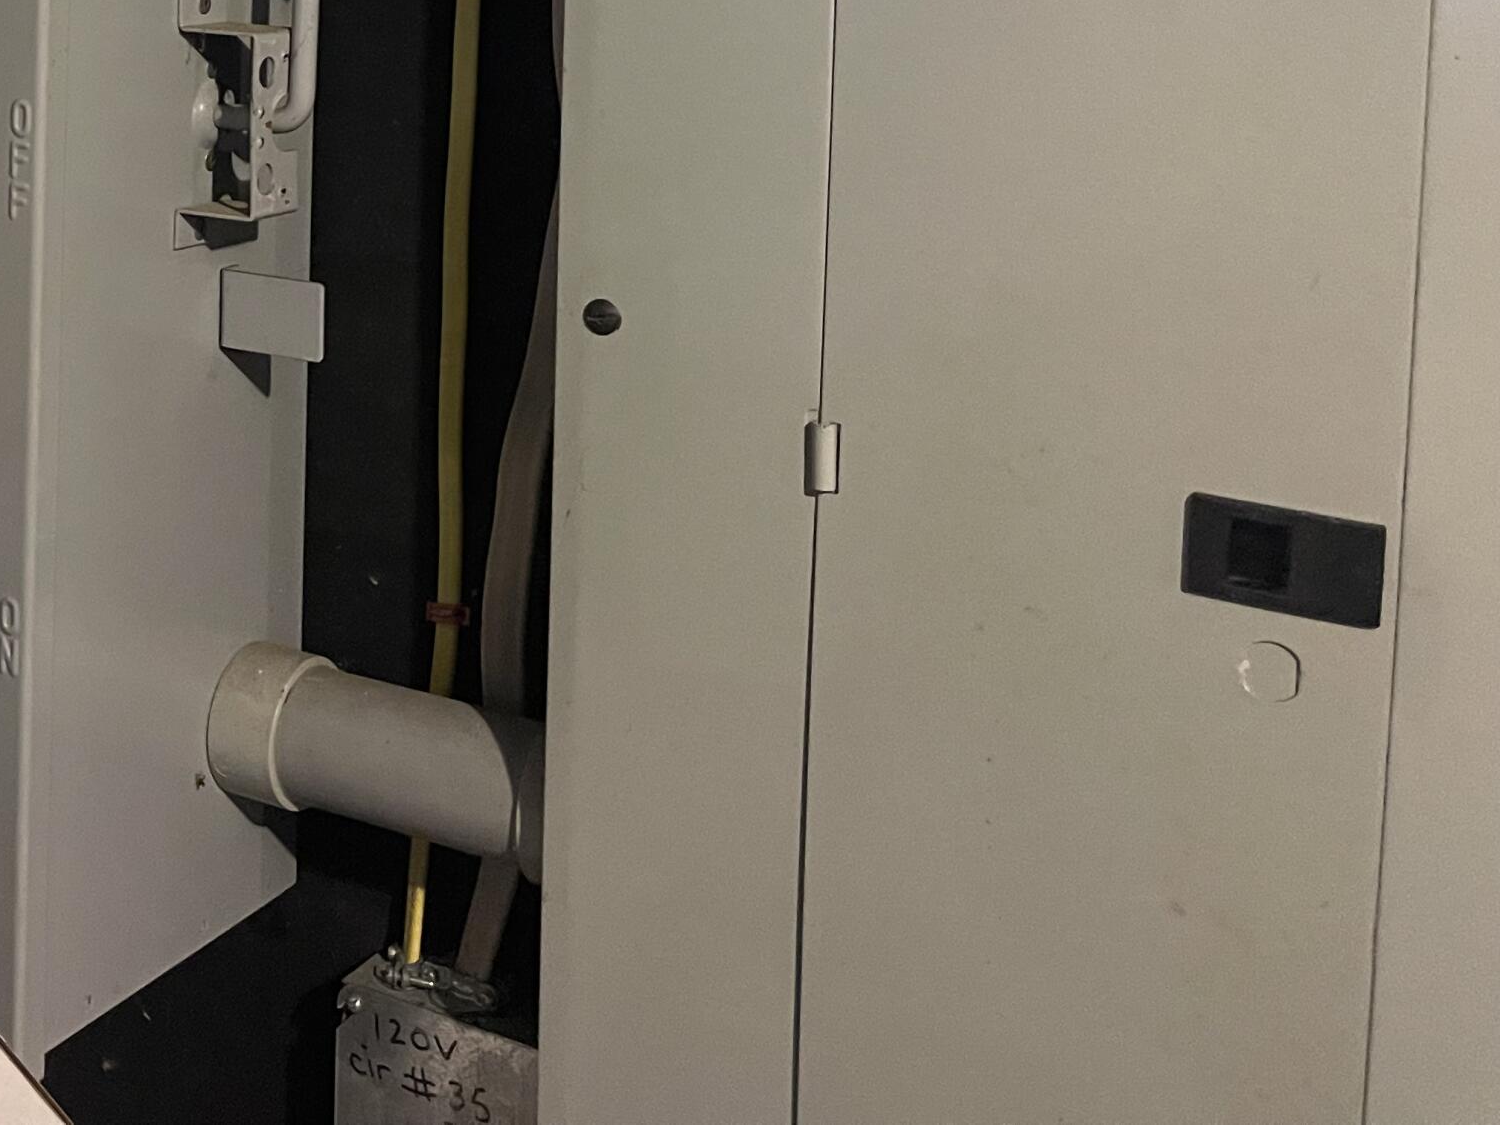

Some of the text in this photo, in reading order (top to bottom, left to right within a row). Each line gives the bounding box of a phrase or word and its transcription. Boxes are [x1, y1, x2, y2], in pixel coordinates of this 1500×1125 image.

[8, 98, 32, 221] OFF
[375, 1013, 457, 1061] 120V
[350, 1044, 391, 1079] cir
